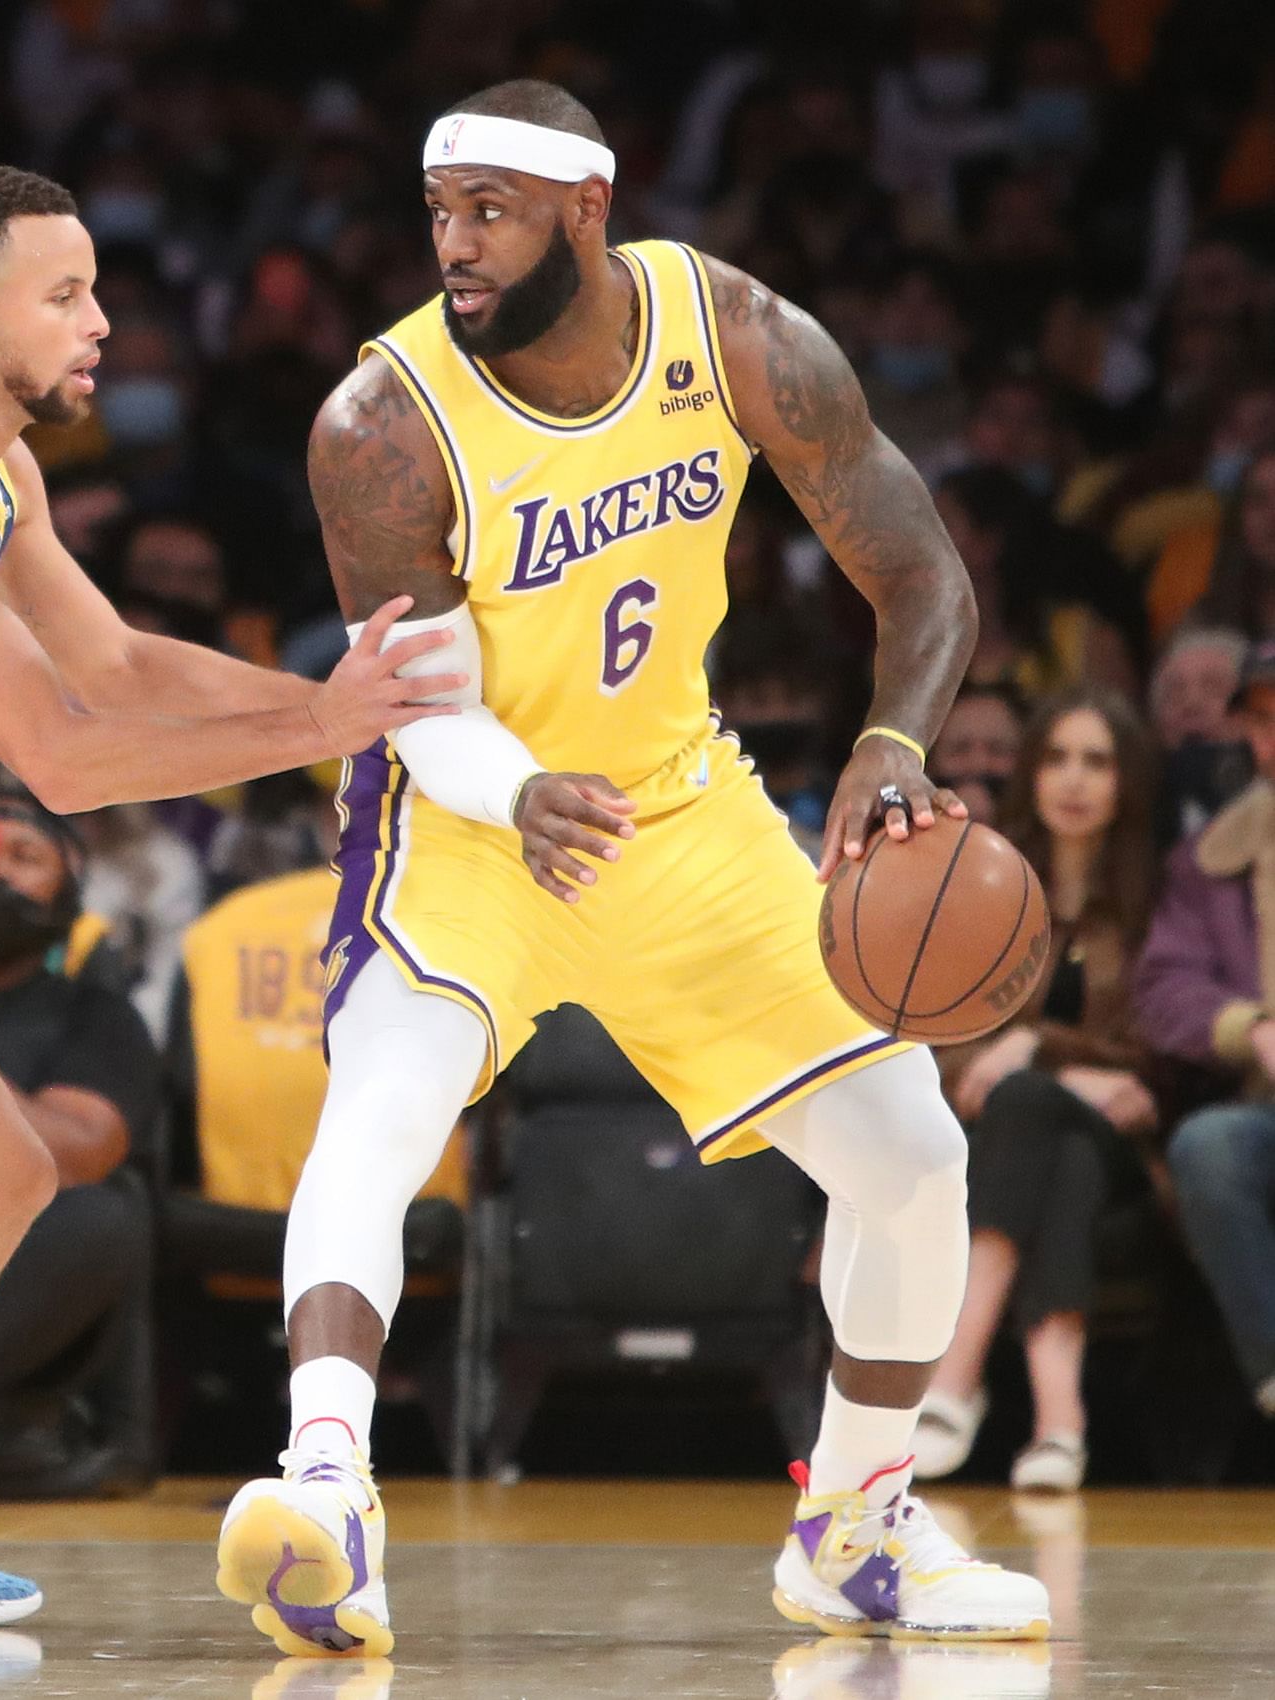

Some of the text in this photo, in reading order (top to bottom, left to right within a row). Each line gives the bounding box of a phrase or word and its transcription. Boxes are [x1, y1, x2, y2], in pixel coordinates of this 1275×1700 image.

[659, 389, 715, 416] bibigo
[502, 449, 725, 592] LAKERS
[600, 577, 658, 693] 6
